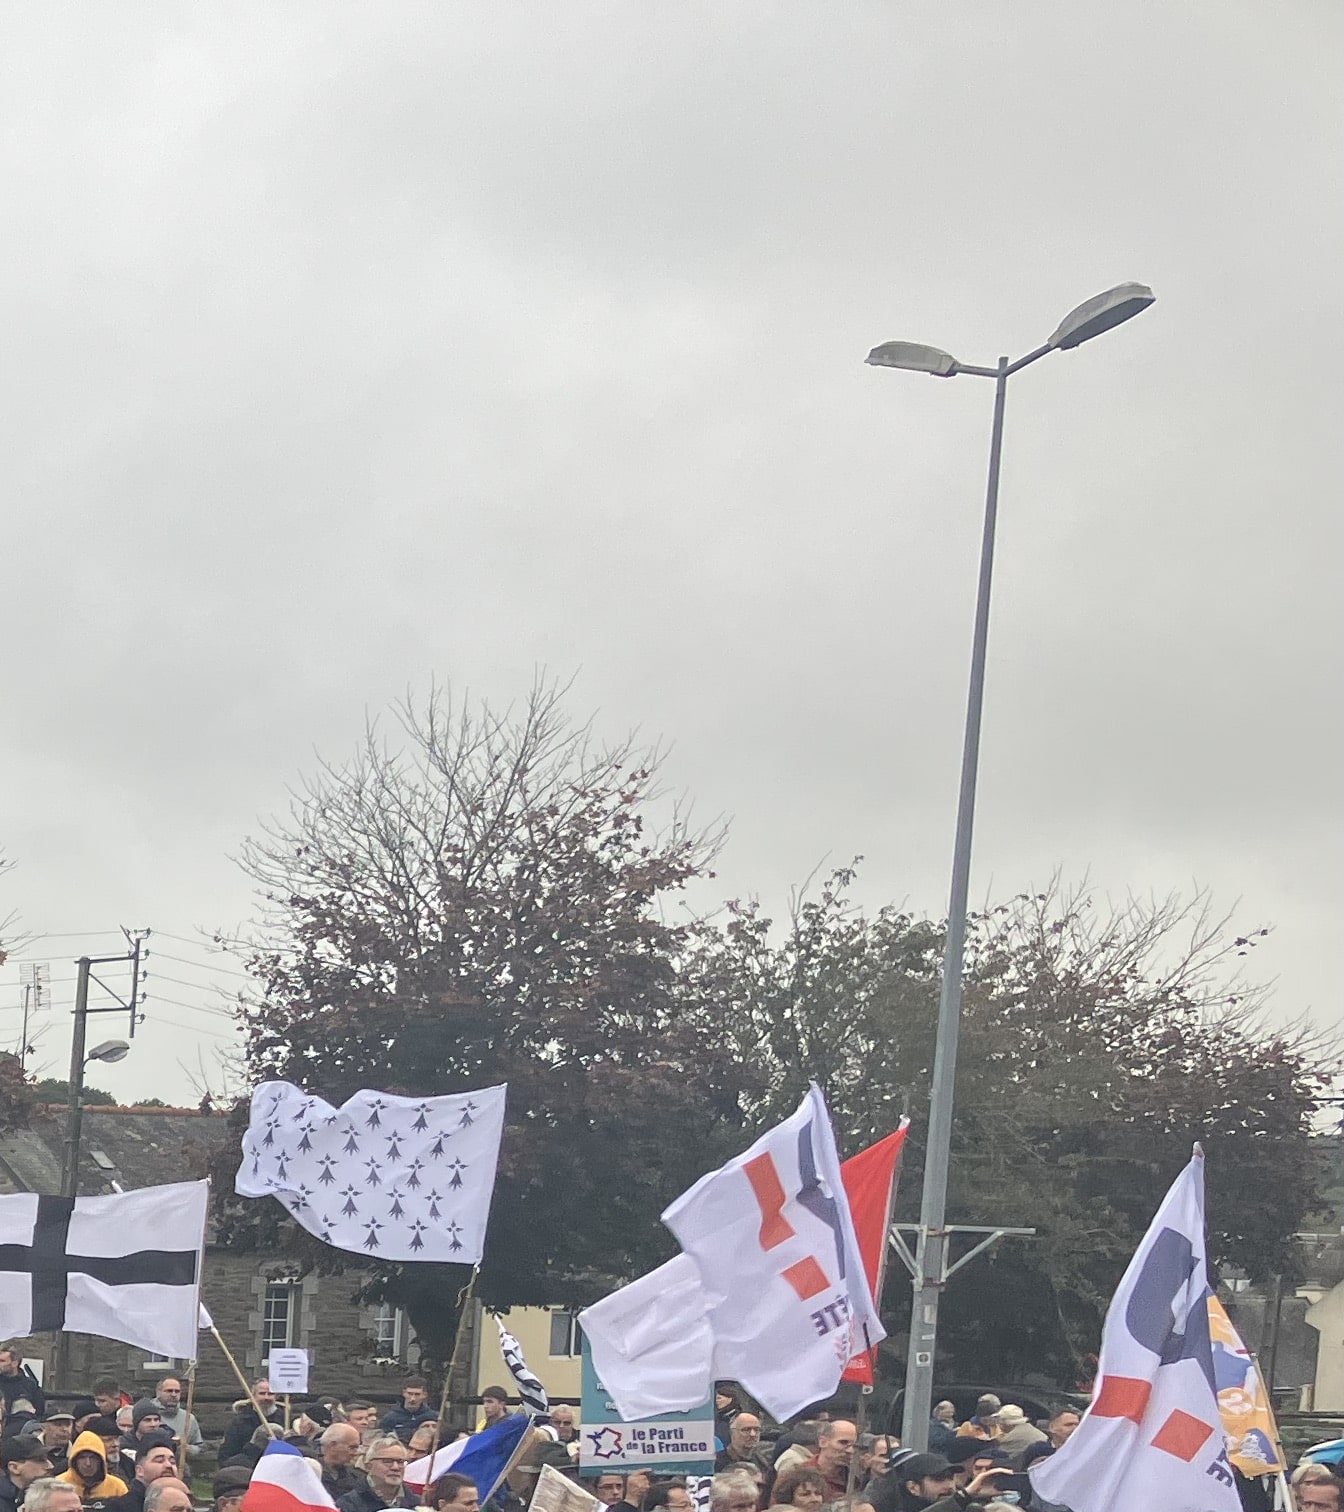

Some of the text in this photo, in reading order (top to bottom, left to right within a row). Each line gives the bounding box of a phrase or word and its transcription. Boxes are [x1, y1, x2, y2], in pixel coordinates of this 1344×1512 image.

[632, 1427, 684, 1441] le Parti
[626, 1442, 708, 1454] de la France
